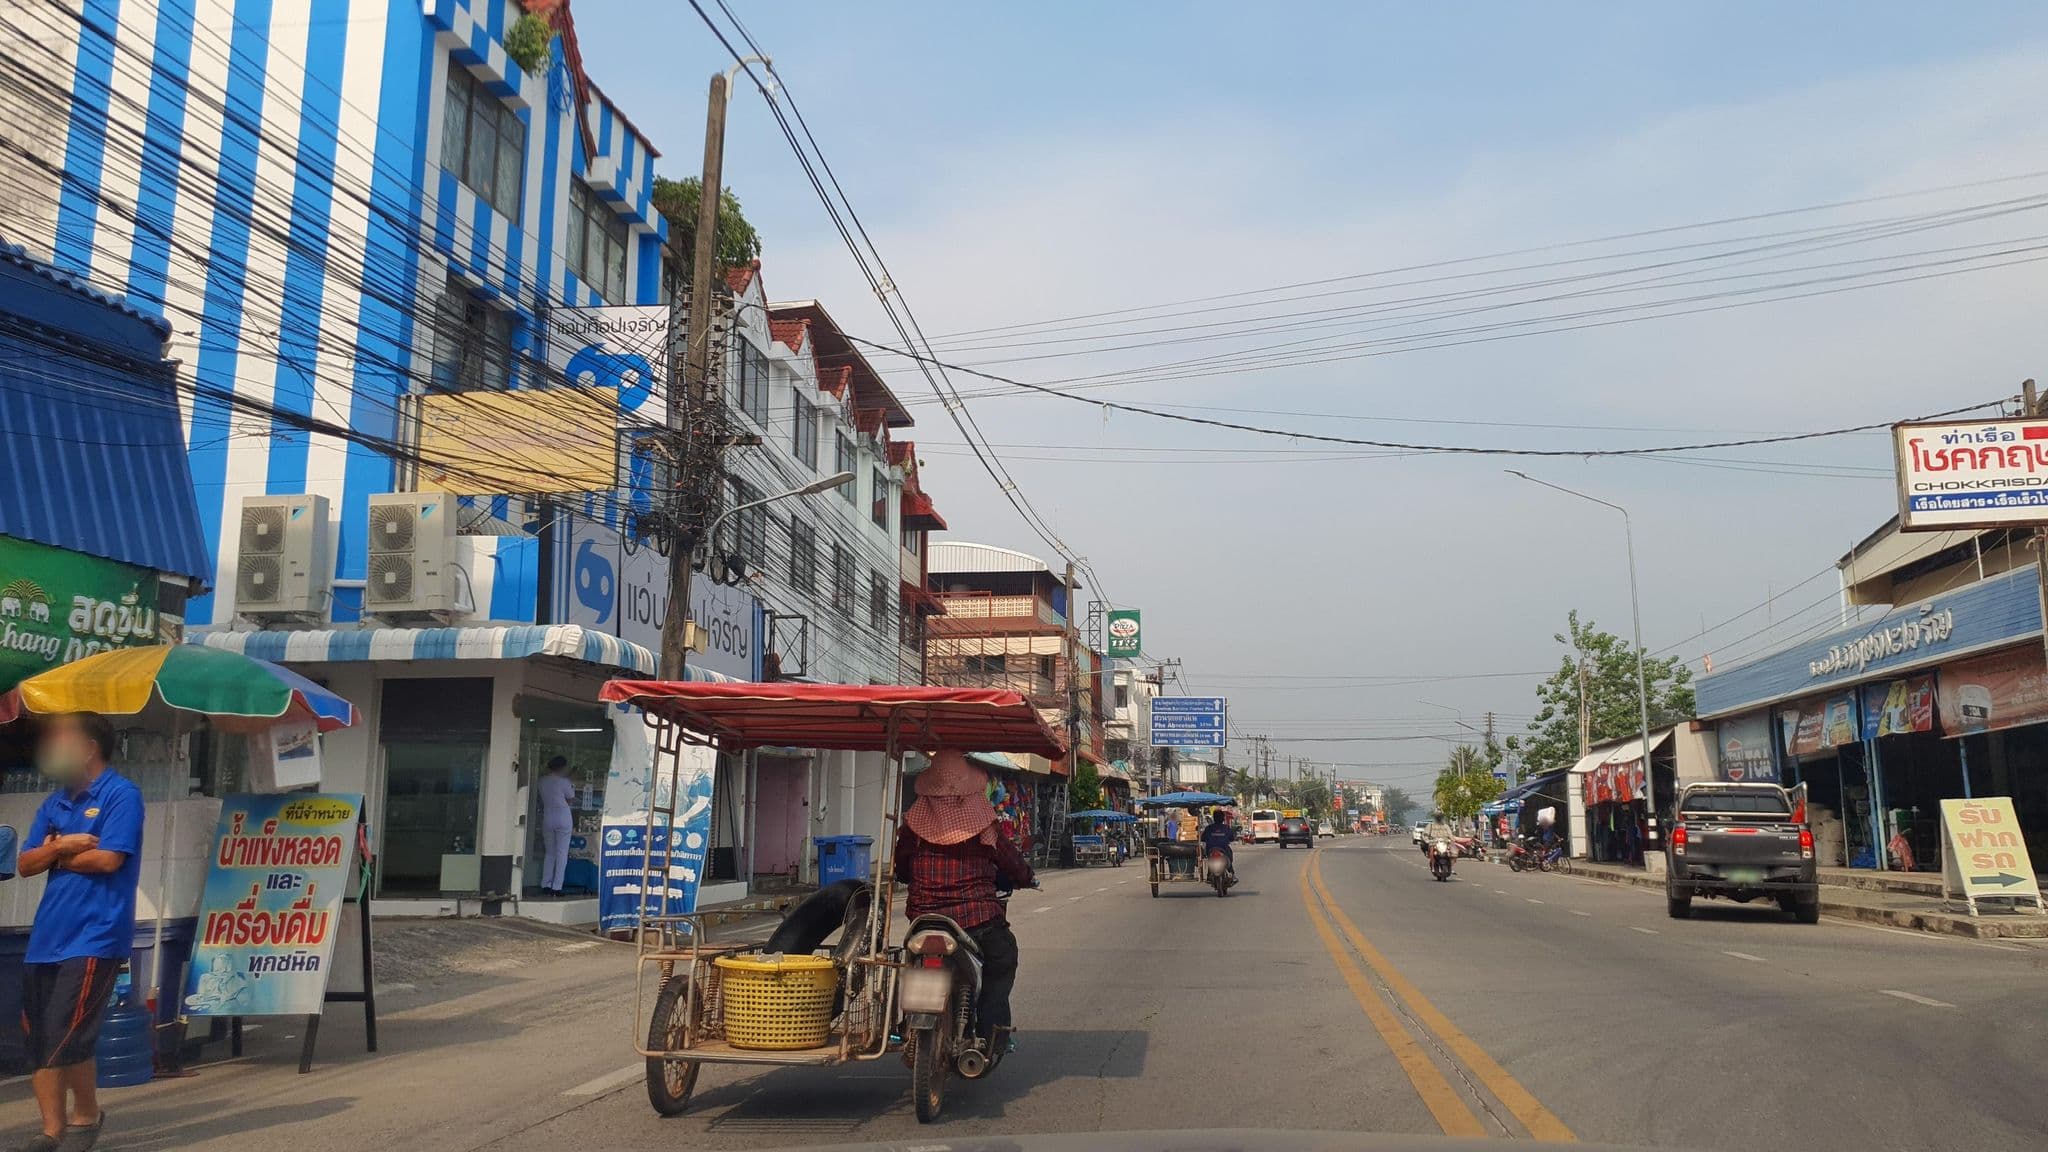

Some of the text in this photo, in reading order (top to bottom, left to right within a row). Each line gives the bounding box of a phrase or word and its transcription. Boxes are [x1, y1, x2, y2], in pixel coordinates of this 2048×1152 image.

[557, 315, 666, 334] แว่นท็อปเจริญ
[1941, 426, 2016, 445] ท่าเรือ
[1915, 491, 2048, 510] เรือโดยสาร เรือเร็วไ
[627, 571, 748, 659] แว่นปเจริญ
[285, 803, 350, 821] ที่นี่จำหน่าย
[219, 813, 342, 866] น้ำแข็งหลอด
[266, 873, 302, 890] และ
[204, 883, 329, 945] เครื่องดื่ม
[248, 950, 321, 979] ทุกชนิด
